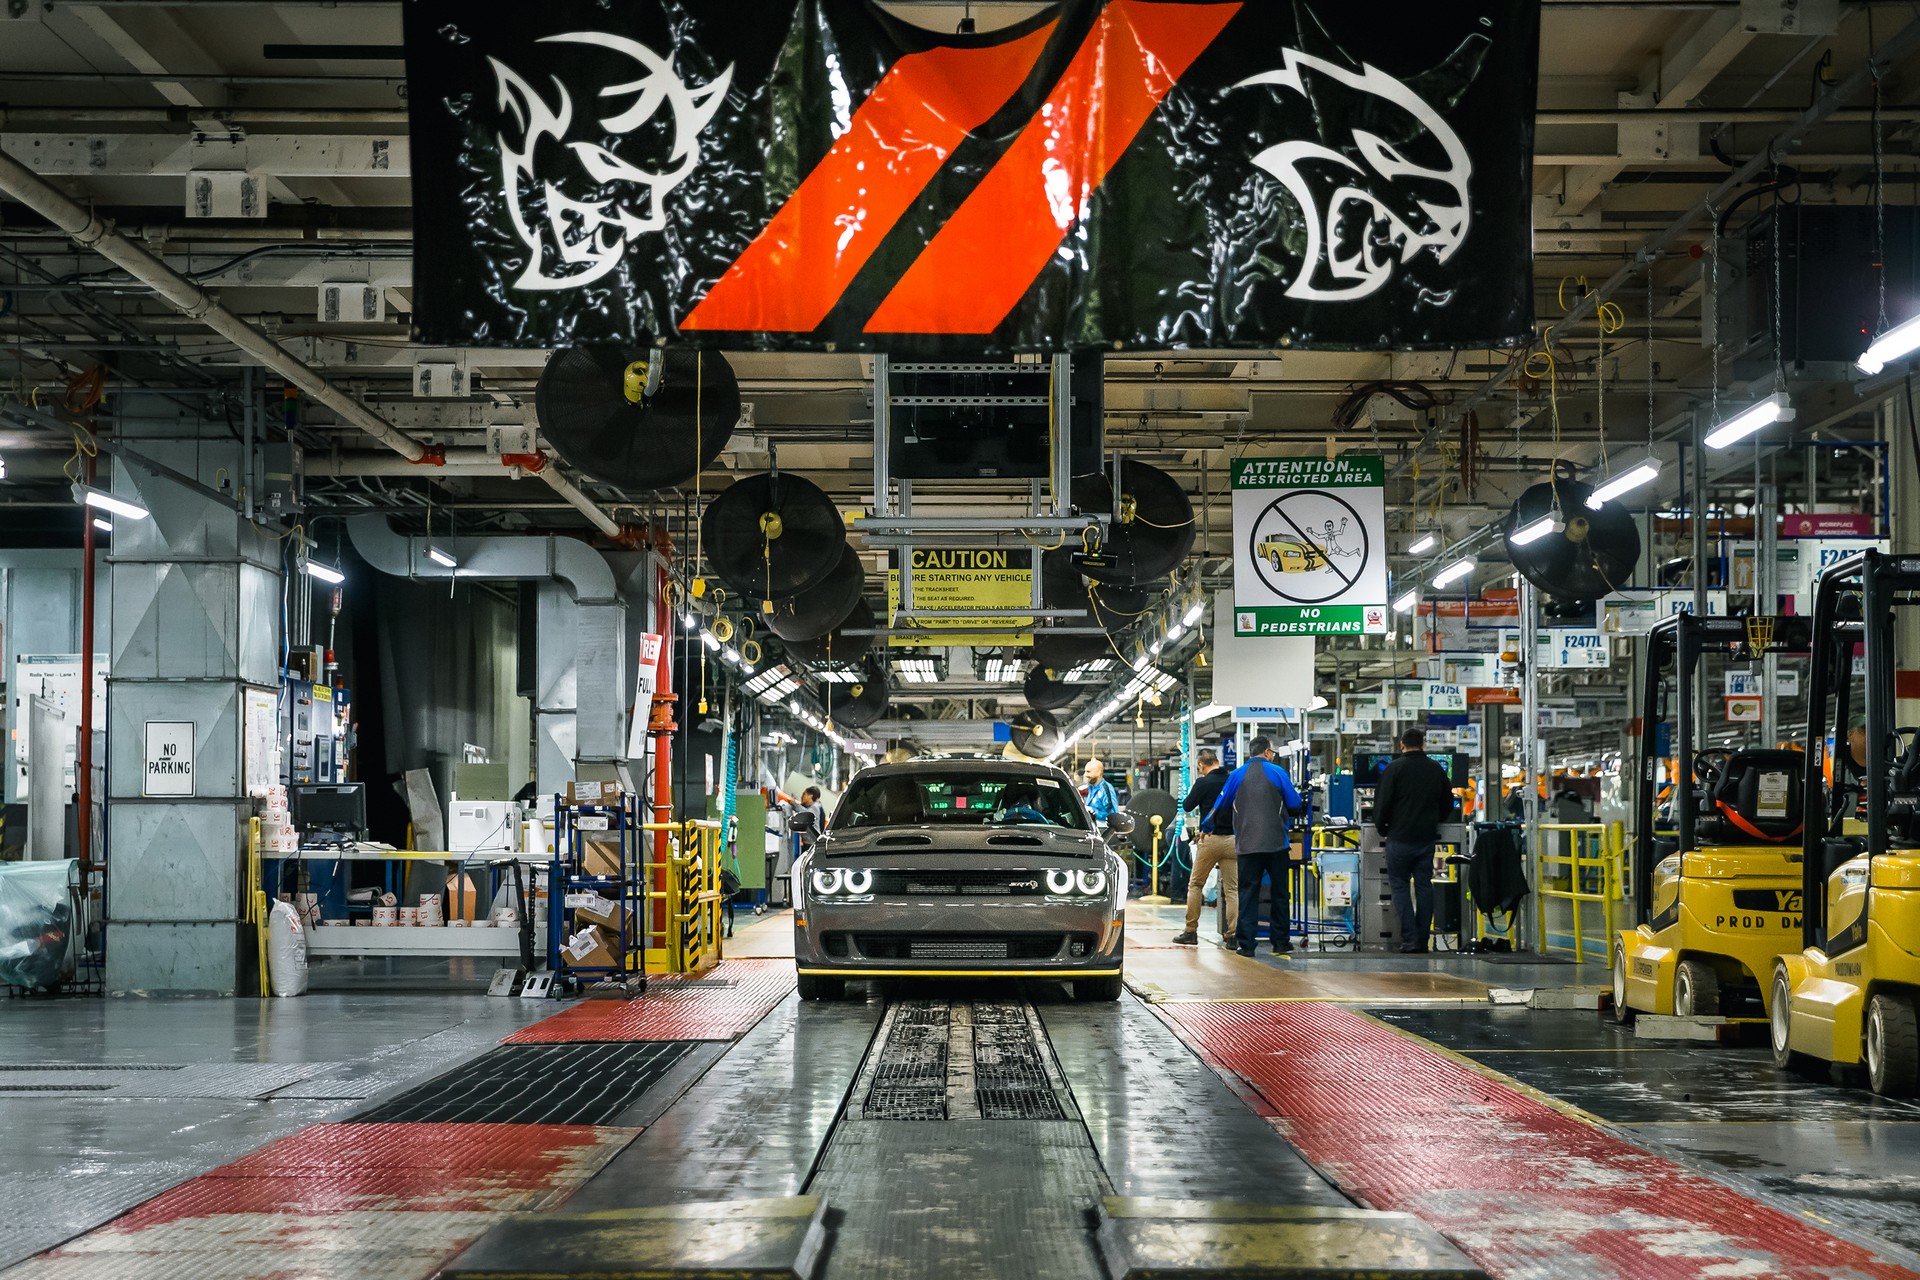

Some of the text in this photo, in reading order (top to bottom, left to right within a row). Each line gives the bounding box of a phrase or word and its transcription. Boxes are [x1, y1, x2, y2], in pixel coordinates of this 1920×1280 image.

[1243, 461, 1367, 474] ATTENTION...
[1238, 473, 1372, 485] RESTRICTED AREA
[911, 550, 1007, 569] CAUTION
[928, 574, 972, 582] STARTING
[974, 574, 992, 582] ANY
[994, 574, 1032, 582] VEHICLE
[1299, 608, 1321, 618] NO
[1260, 621, 1361, 633] PEDESTRIANS
[1565, 635, 1602, 648] F2477L
[163, 743, 177, 756] NO
[853, 742, 872, 750] TEAM
[148, 761, 191, 775] PARKING
[1775, 890, 1802, 911] Ya
[1716, 916, 1765, 929] PROD
